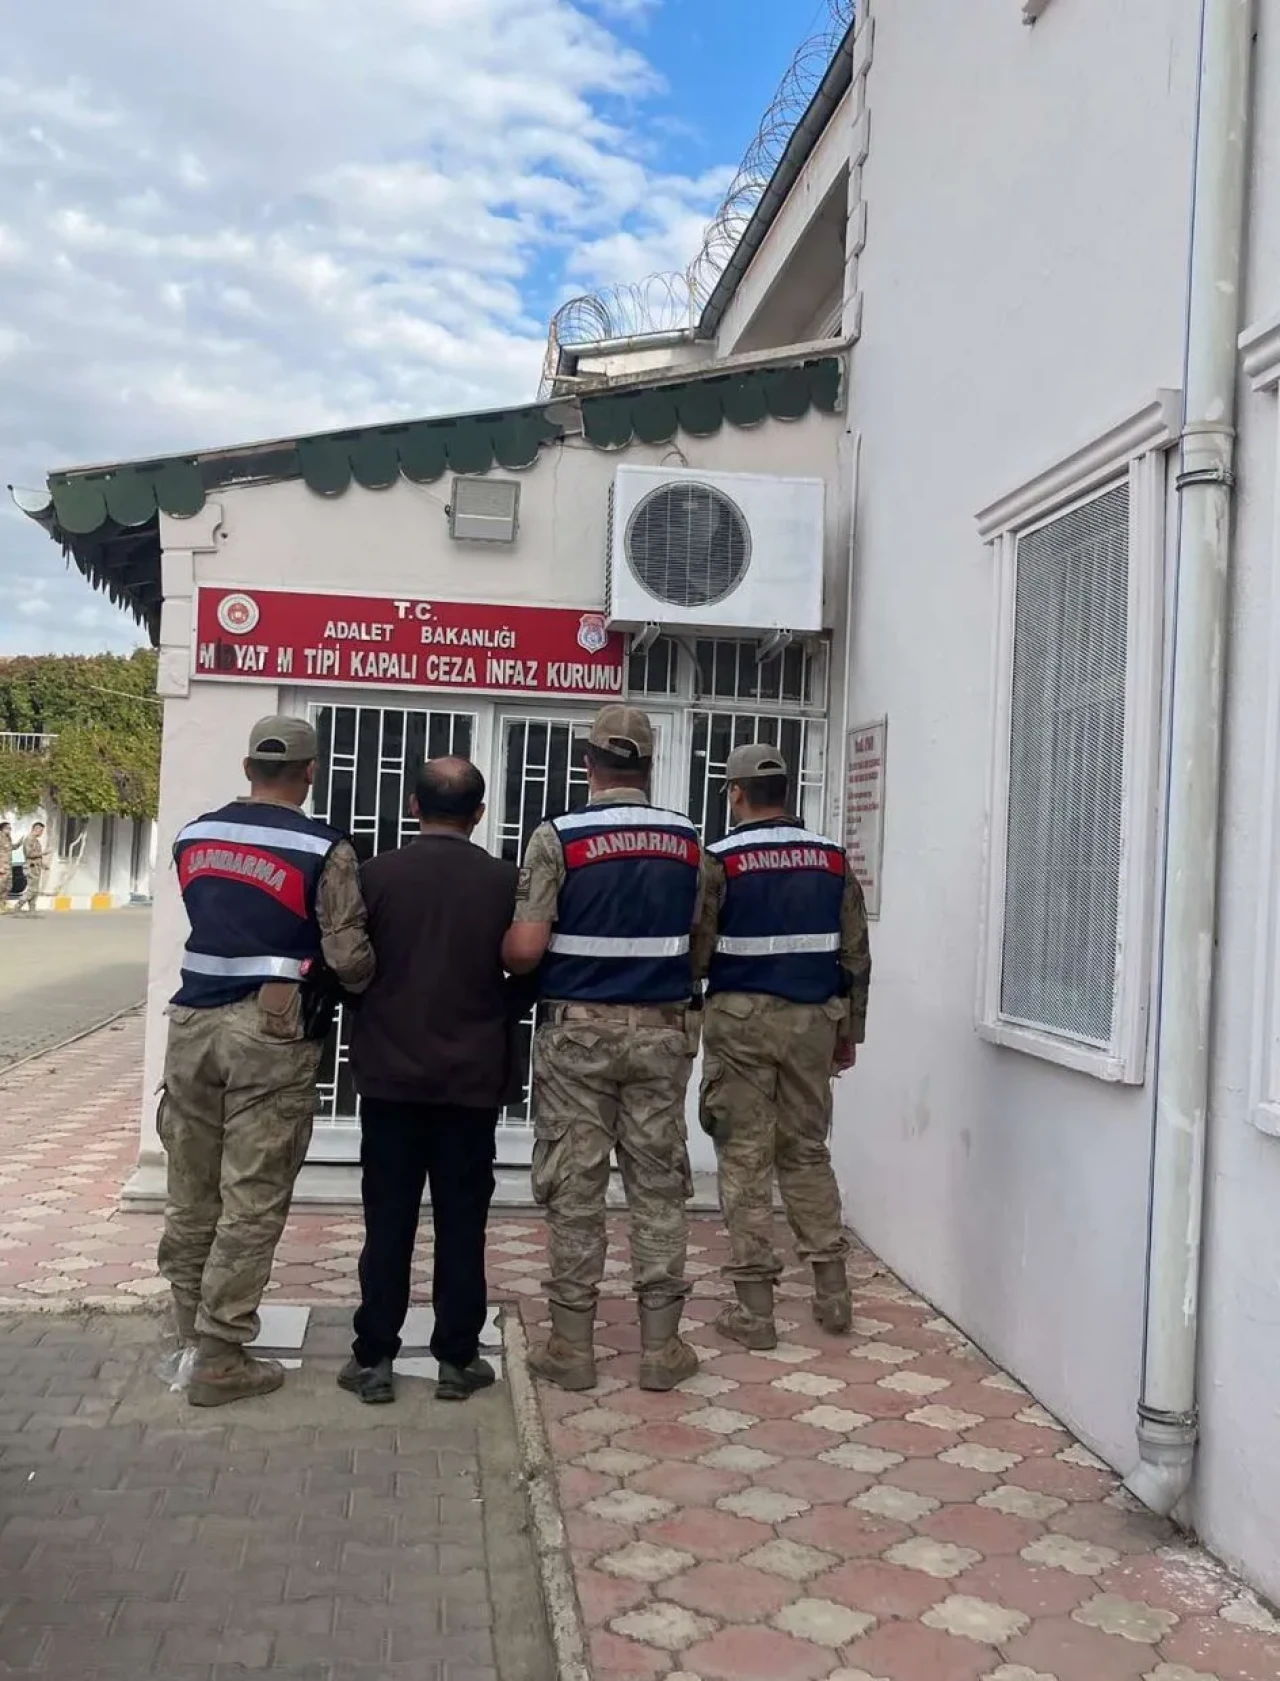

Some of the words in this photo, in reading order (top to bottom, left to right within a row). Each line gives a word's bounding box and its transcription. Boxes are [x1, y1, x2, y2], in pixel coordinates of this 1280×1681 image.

[394, 600, 438, 621] T.C.
[323, 620, 394, 642] ADALET
[420, 625, 516, 649] BAKANLIĞI
[199, 641, 269, 672] MYAT
[277, 647, 293, 673] M
[304, 644, 340, 676] TİPİ
[350, 650, 417, 680] KAPALI
[426, 654, 477, 683] CEZA
[486, 651, 538, 687] İNFAZ
[547, 661, 622, 691] KURUMU
[586, 831, 687, 859] JANDARMA
[187, 849, 287, 891] JANDARMA
[737, 849, 829, 872] JANDARMA
